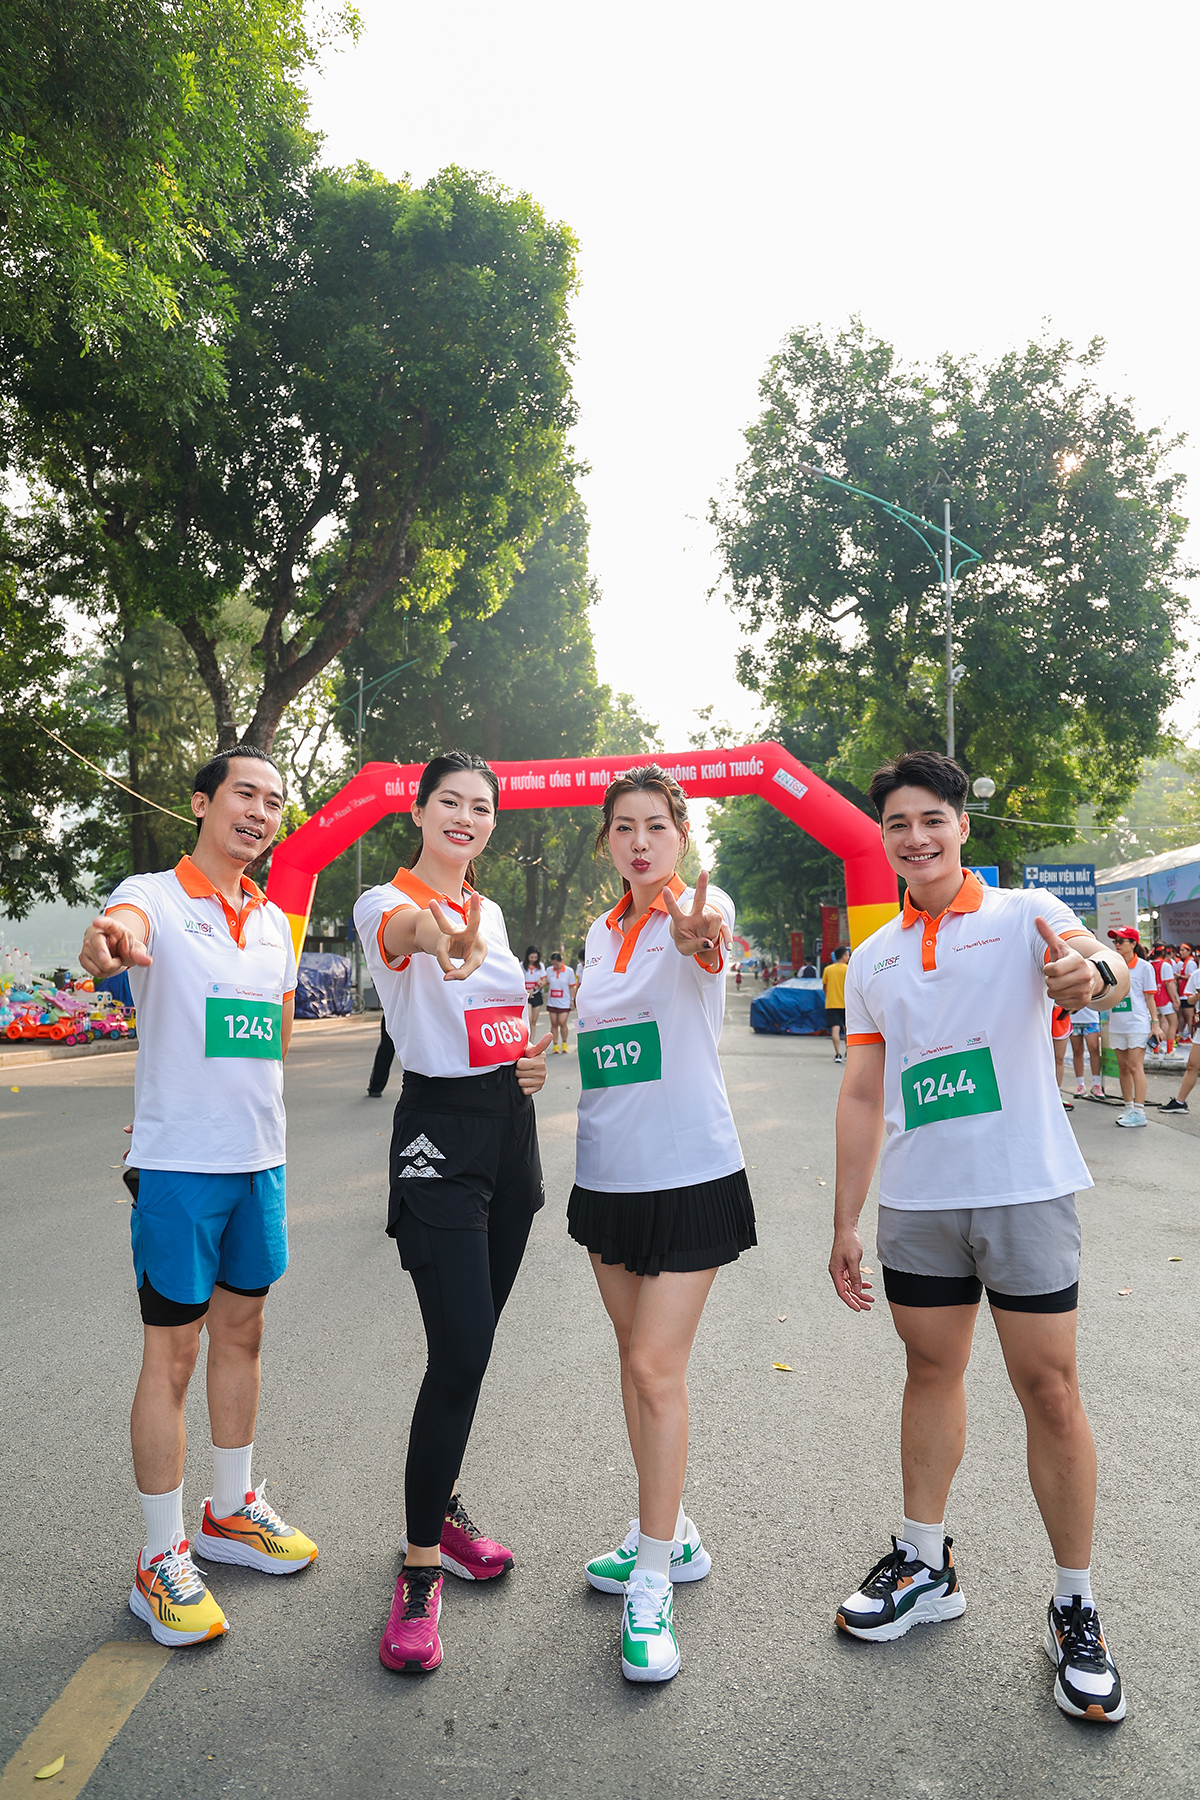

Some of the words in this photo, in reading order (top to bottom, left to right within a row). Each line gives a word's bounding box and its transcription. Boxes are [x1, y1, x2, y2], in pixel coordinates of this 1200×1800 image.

[385, 778, 404, 796] GIẢI
[510, 770, 545, 790] HƯỞNG
[550, 770, 571, 788] ỨNG
[575, 770, 585, 786] VÌ
[590, 769, 610, 786] MÔI
[701, 761, 726, 780] KHÓI
[729, 756, 764, 777] THUỐC
[1039, 869, 1058, 884] BỆNH
[1058, 869, 1075, 884] VIỆN
[1075, 868, 1091, 882] MẮT
[1065, 887, 1076, 896] CAO
[224, 1014, 273, 1041] 1243
[481, 1020, 522, 1047] 0183
[592, 1040, 642, 1070] 1219
[912, 1069, 976, 1106] 1244
